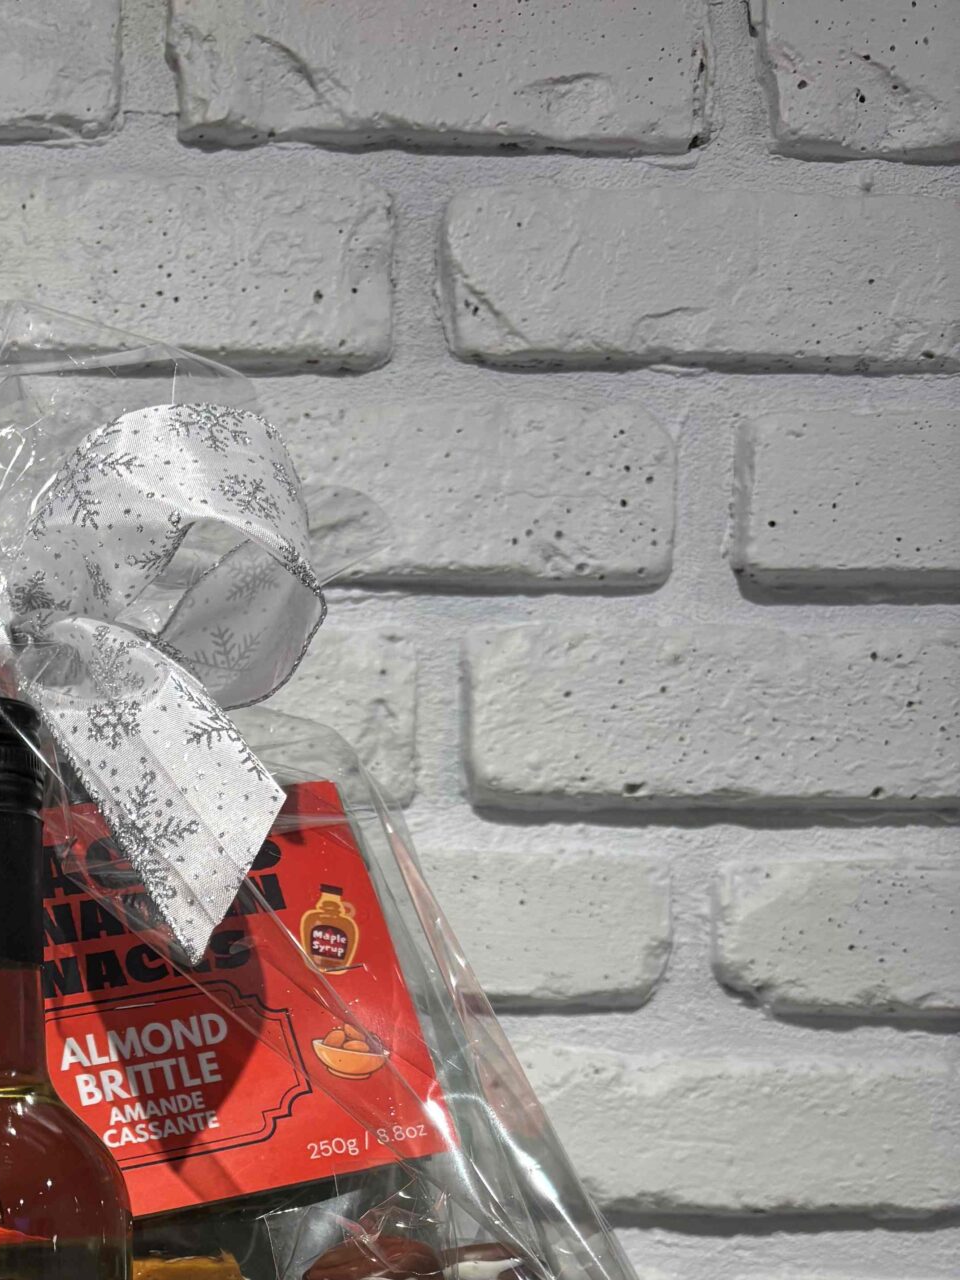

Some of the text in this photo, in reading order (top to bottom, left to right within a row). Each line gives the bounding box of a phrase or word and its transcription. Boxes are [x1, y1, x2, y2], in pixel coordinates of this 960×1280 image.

[312, 929, 347, 944] Maple
[312, 941, 345, 957] Syrup
[60, 1013, 228, 1071] ALMOND
[75, 1051, 222, 1106] BRITTLE
[109, 1091, 206, 1126] AMANDE
[102, 1110, 220, 1148] CASSANTE
[306, 1137, 359, 1159] 250g
[376, 1124, 428, 1145] 8.8oz
